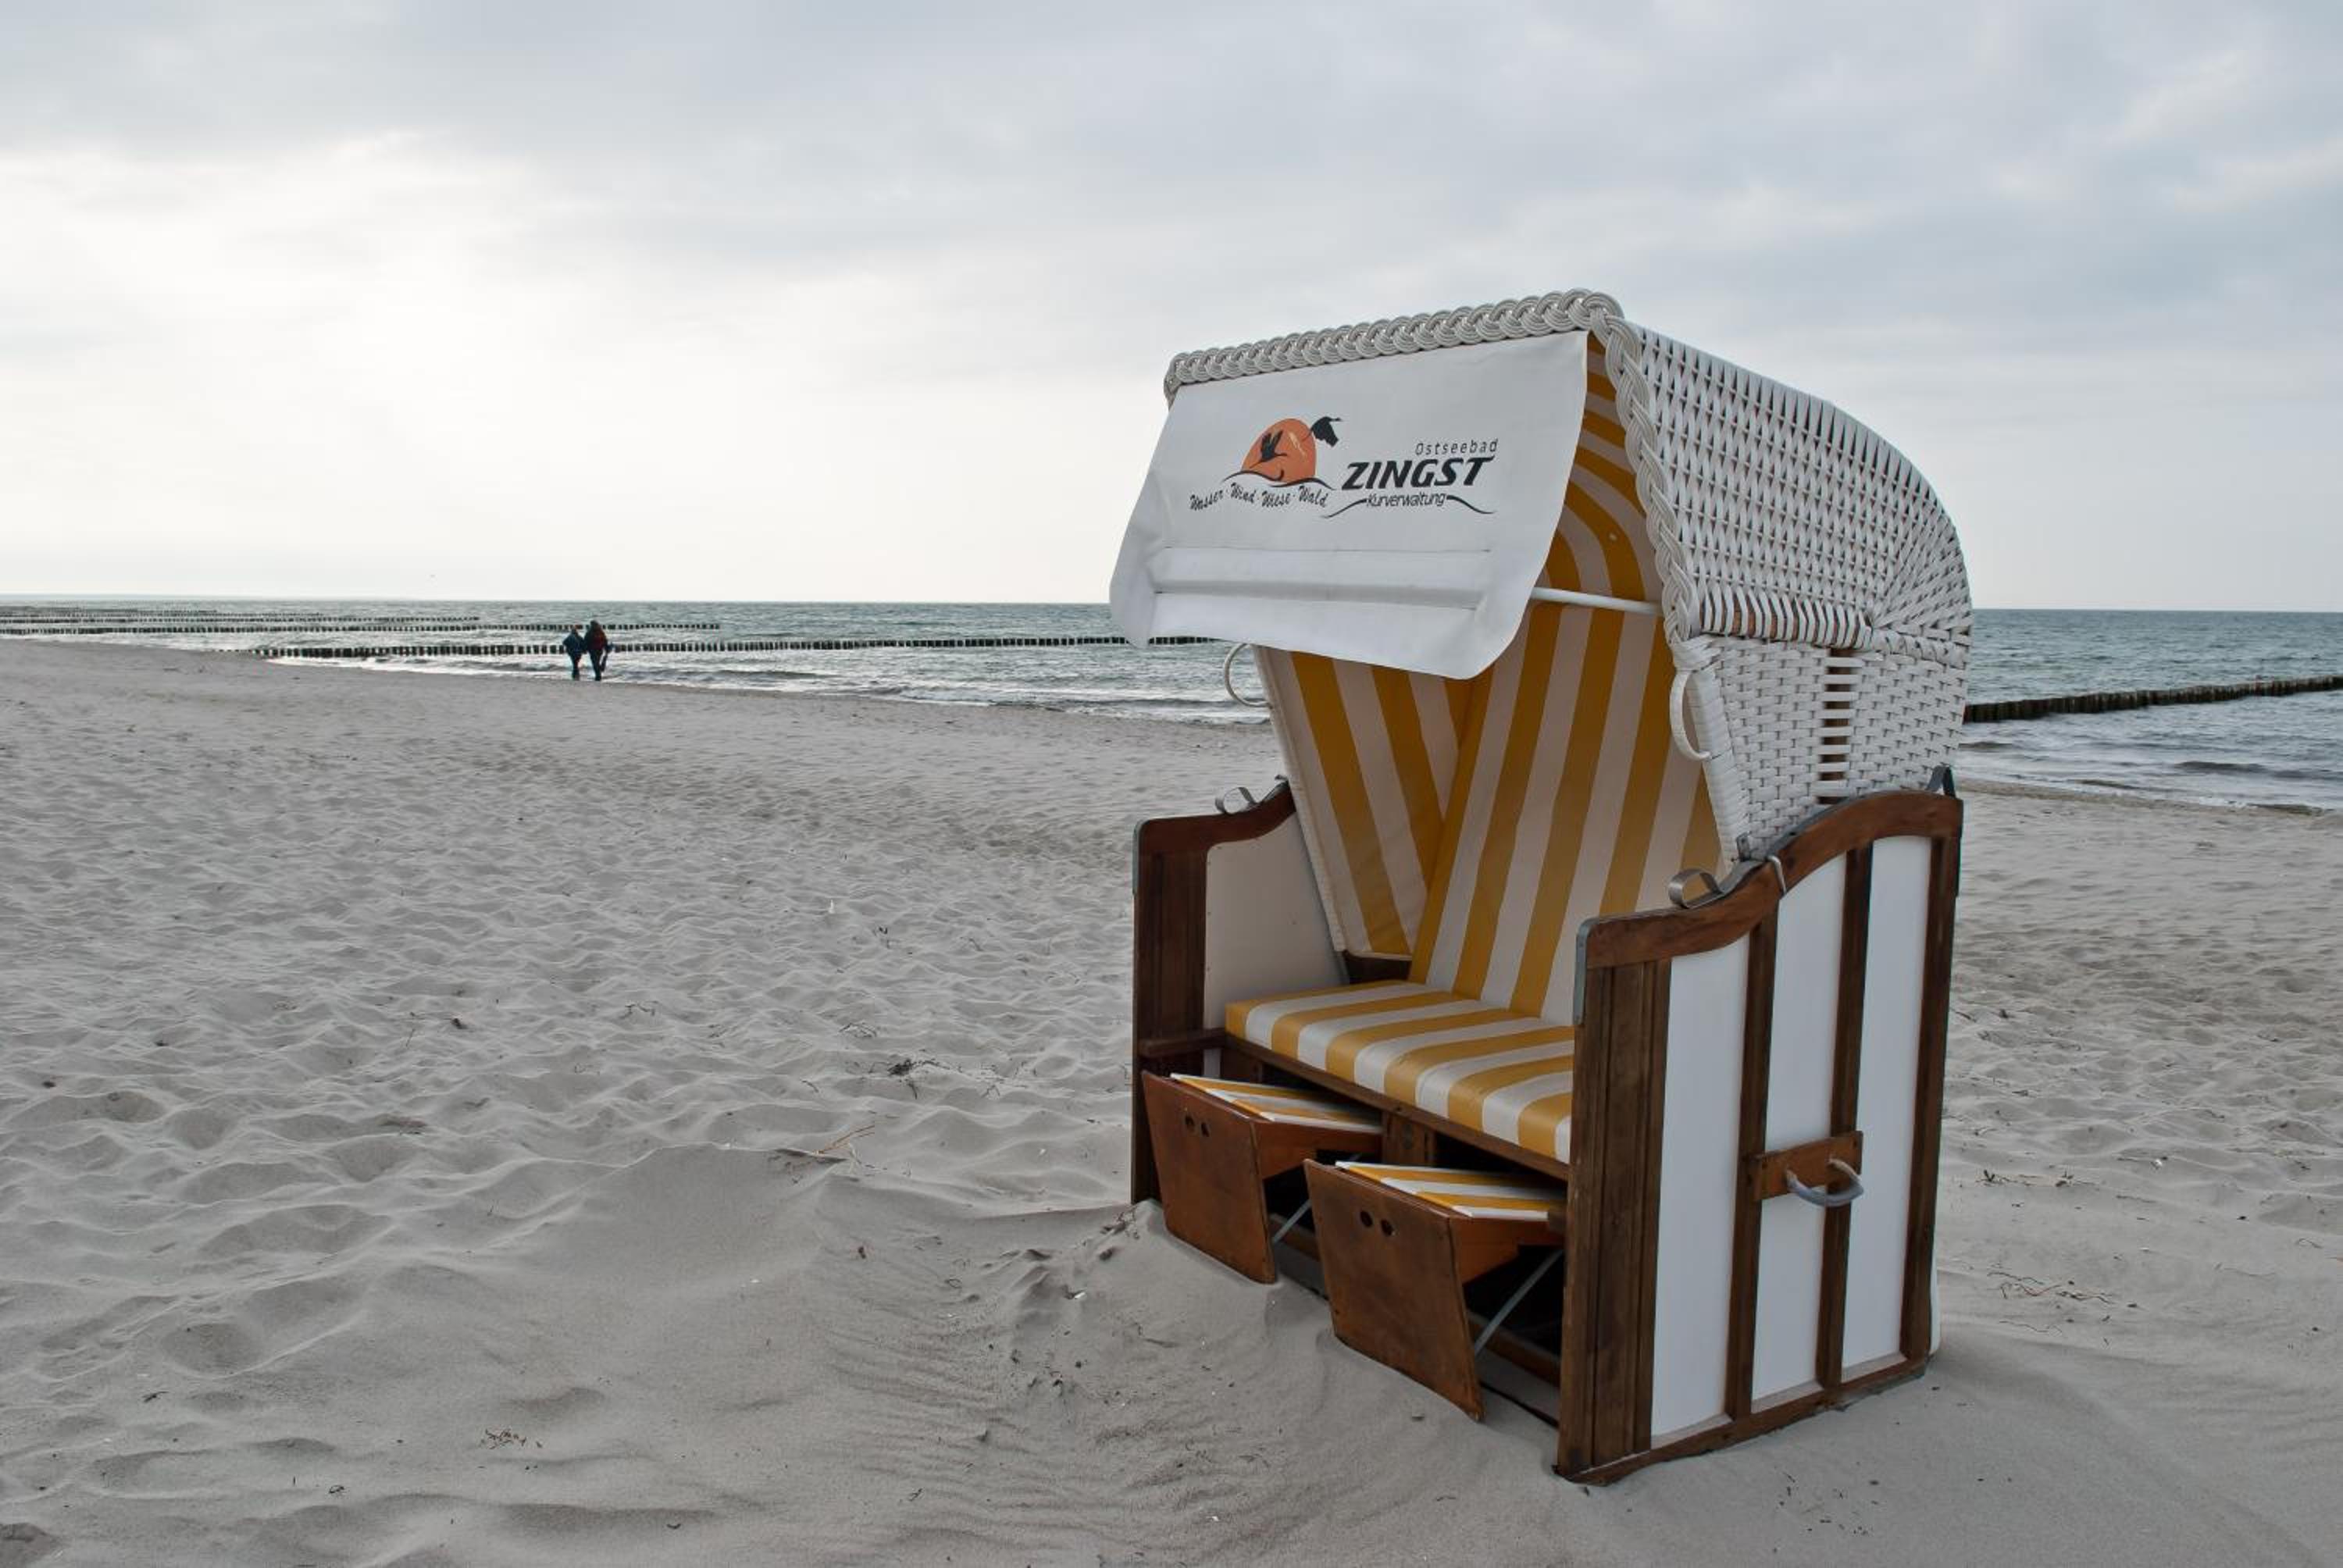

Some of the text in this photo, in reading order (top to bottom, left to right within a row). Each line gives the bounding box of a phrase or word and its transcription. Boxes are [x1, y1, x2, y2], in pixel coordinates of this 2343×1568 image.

[1415, 438, 1499, 455] Ostseebad
[1342, 455, 1495, 490] ZINGST
[1298, 485, 1328, 508] Wald
[1367, 492, 1446, 507] Kurverwaltung
